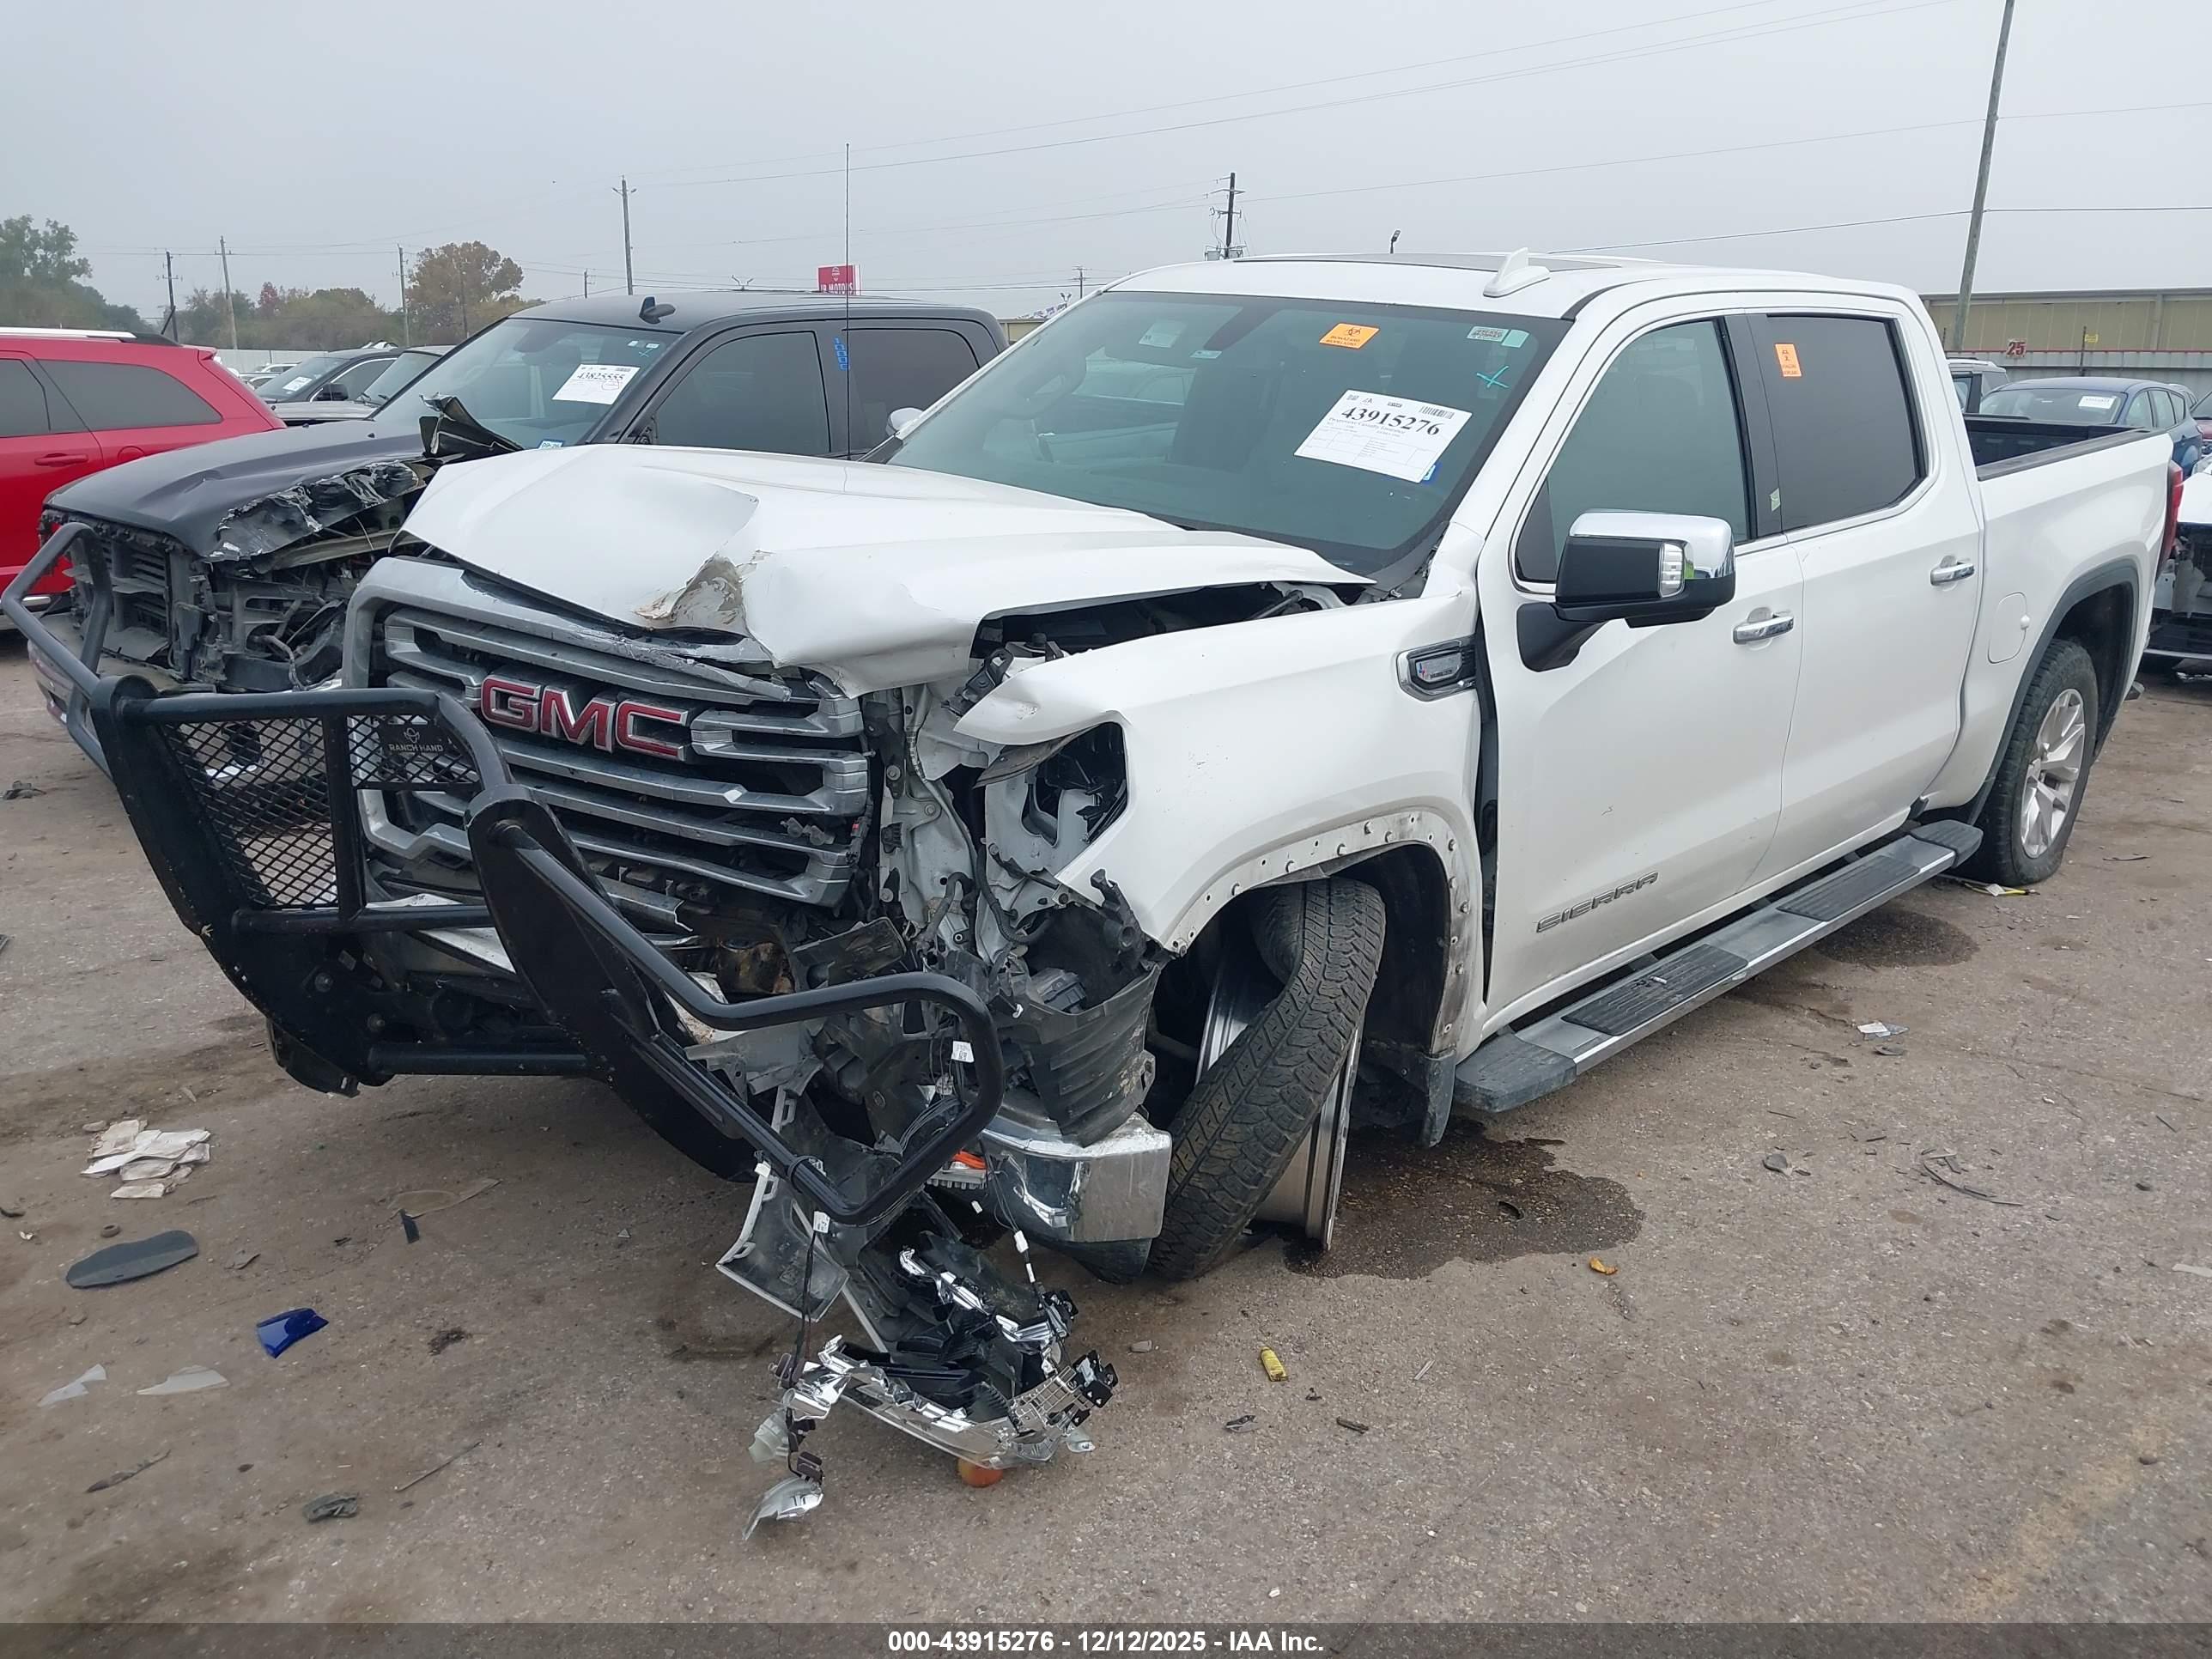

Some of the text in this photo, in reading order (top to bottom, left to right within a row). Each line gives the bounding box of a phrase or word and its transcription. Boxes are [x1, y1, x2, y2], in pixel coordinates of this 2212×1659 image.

[2006, 341, 2027, 356] 25
[1341, 406, 1444, 435] 43915276
[481, 675, 689, 762] GMC
[419, 744, 444, 752] HAND
[1536, 872, 1659, 933] SIERRA
